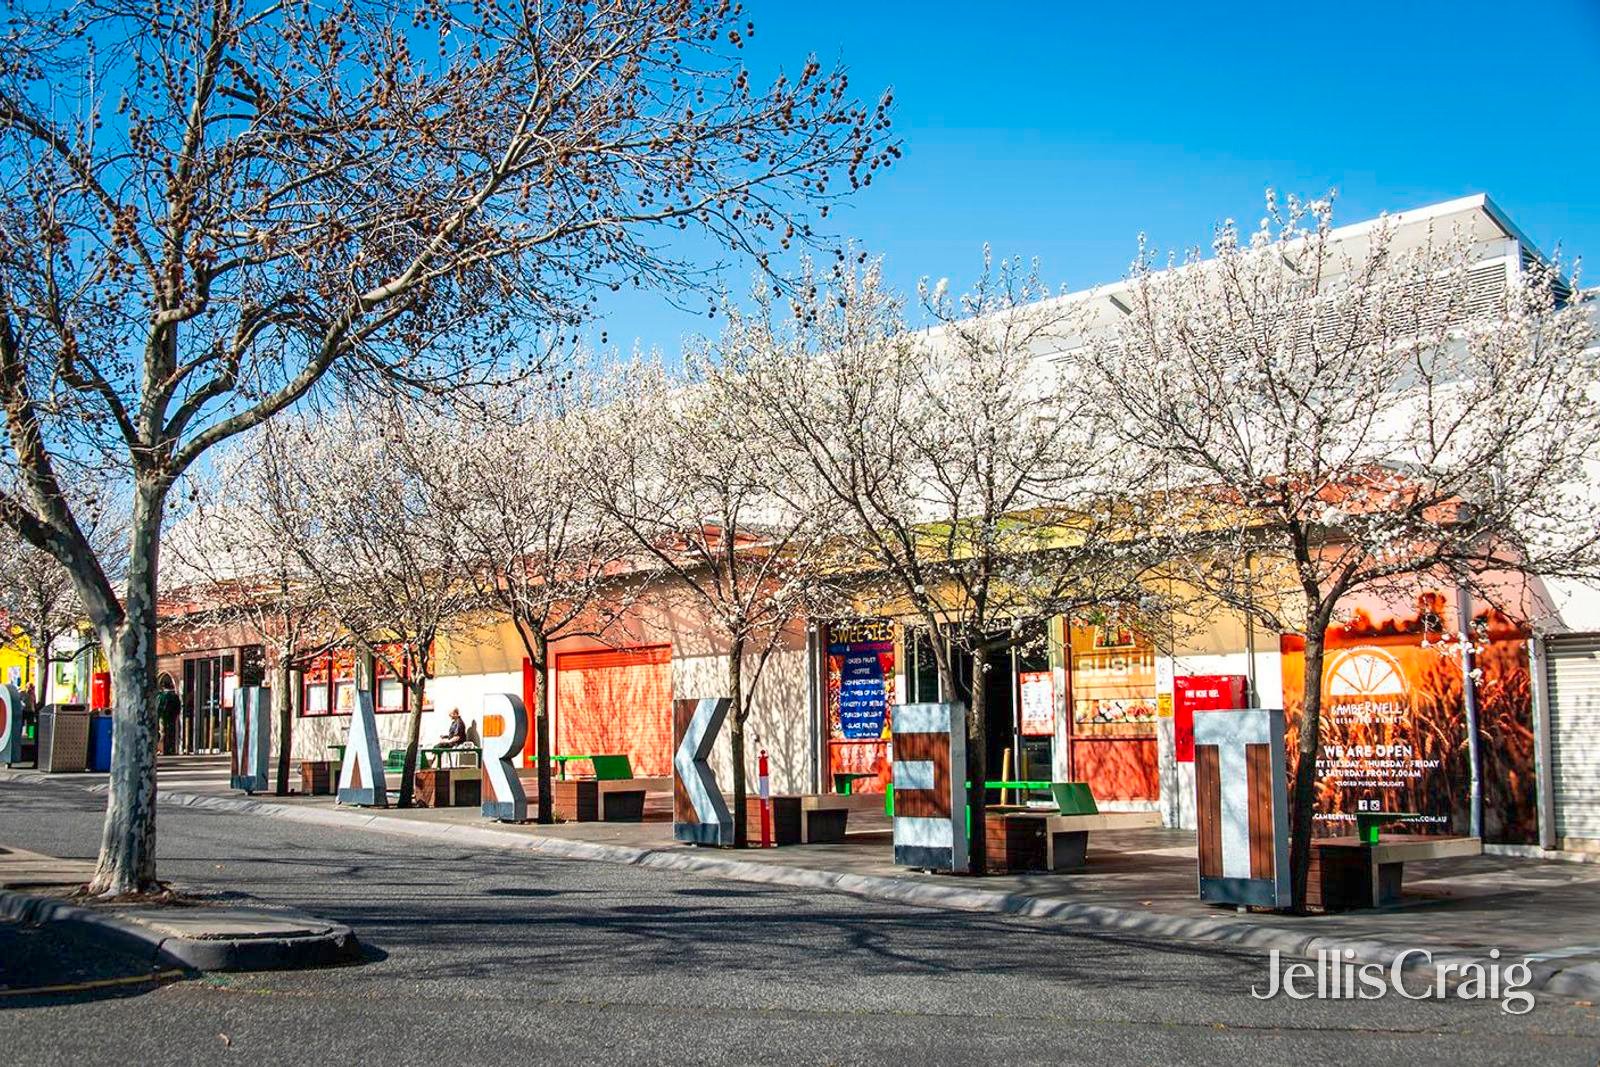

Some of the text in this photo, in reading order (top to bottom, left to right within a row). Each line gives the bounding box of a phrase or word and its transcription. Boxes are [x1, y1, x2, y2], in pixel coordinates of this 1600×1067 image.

[1078, 655, 1152, 676] SUSHI
[1324, 744, 1413, 758] WE ARE OPEN
[1410, 760, 1440, 769] FRIDAY
[1318, 769, 1421, 778] & SATURDAY FROM 7.00AM
